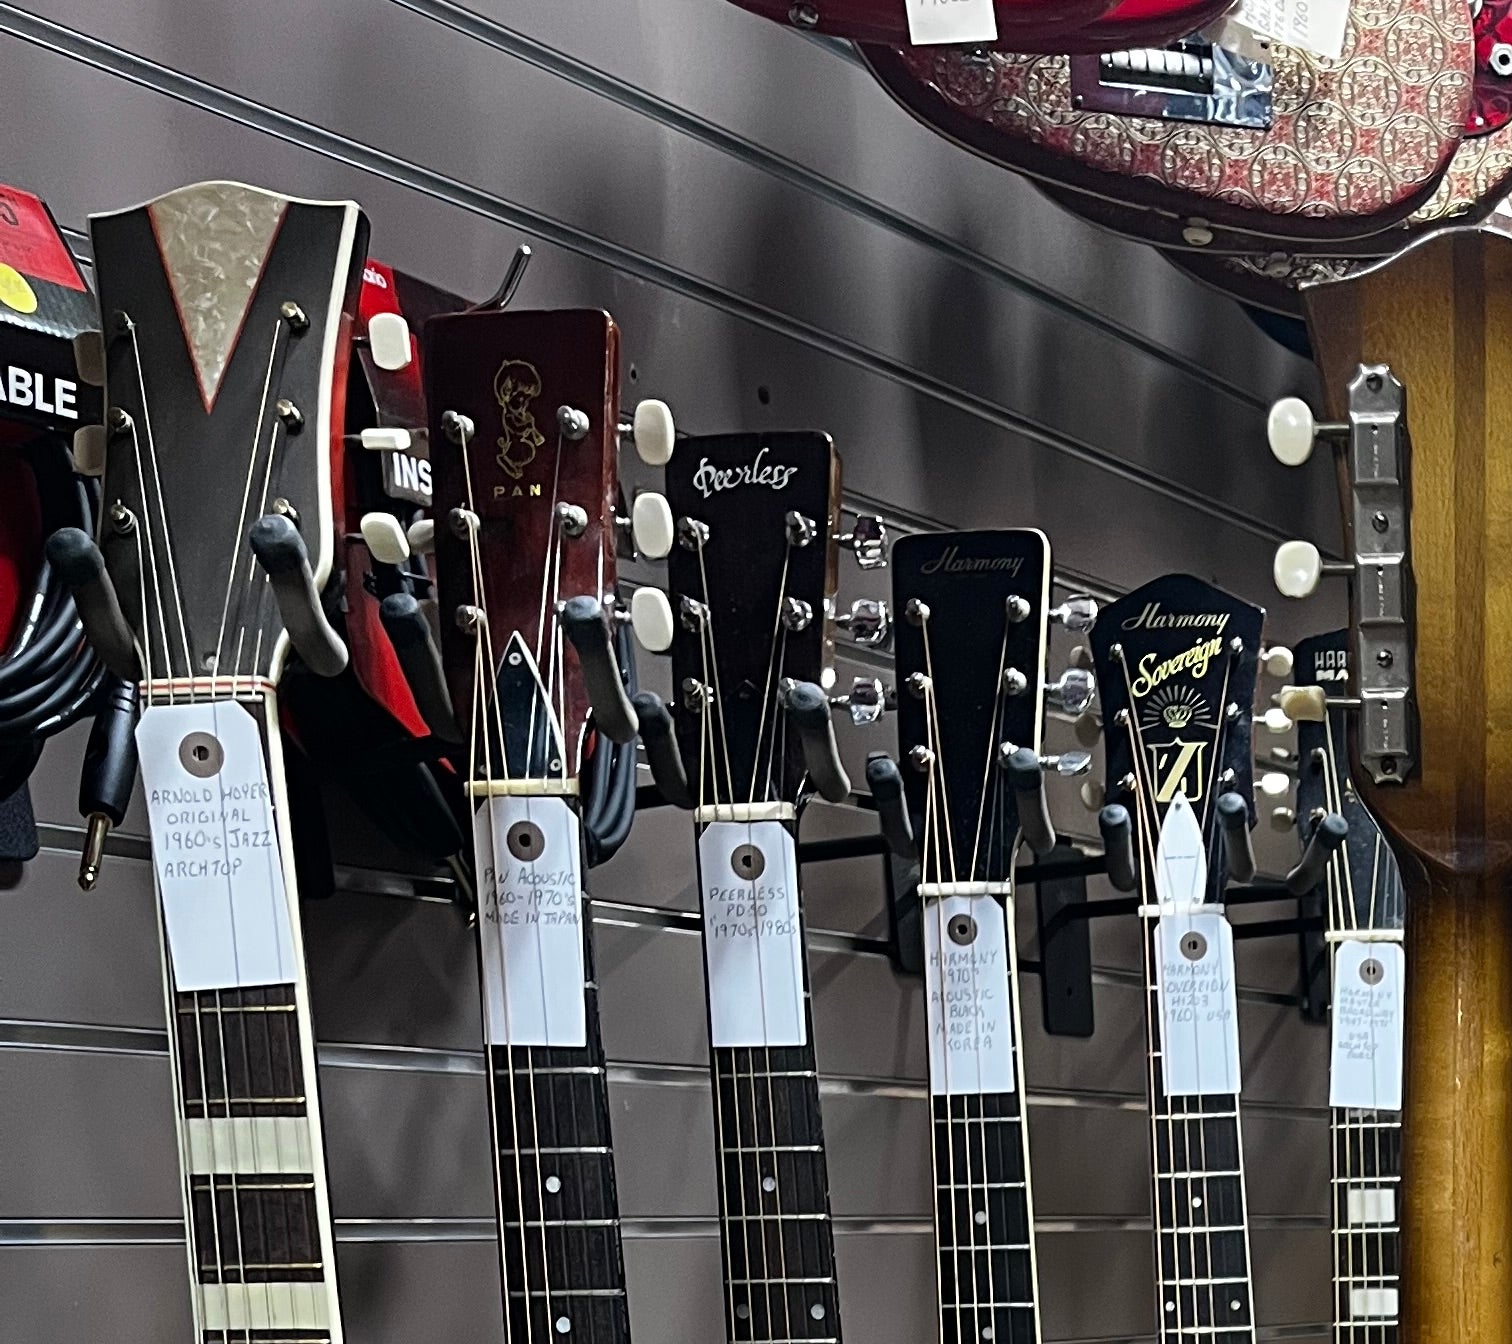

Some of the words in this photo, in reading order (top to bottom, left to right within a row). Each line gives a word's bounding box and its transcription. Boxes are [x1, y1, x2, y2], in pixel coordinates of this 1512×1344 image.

[392, 452, 433, 496] INS
[693, 447, 798, 498] Peerless
[494, 484, 541, 498] PAN
[921, 545, 1024, 578] Harmony
[1121, 603, 1230, 634] Harmony
[1131, 635, 1222, 698] Sovereign
[1314, 650, 1347, 669] HAR
[1316, 669, 1349, 681] MA
[151, 787, 213, 805] ARNOLD
[221, 783, 268, 801] HOYER
[166, 808, 250, 825] ORIGINAL
[228, 828, 272, 849] JAZZ
[709, 886, 785, 902] PEERLESS
[931, 988, 994, 1003] AOUSTIC
[1164, 978, 1231, 993] OVEREIGN
